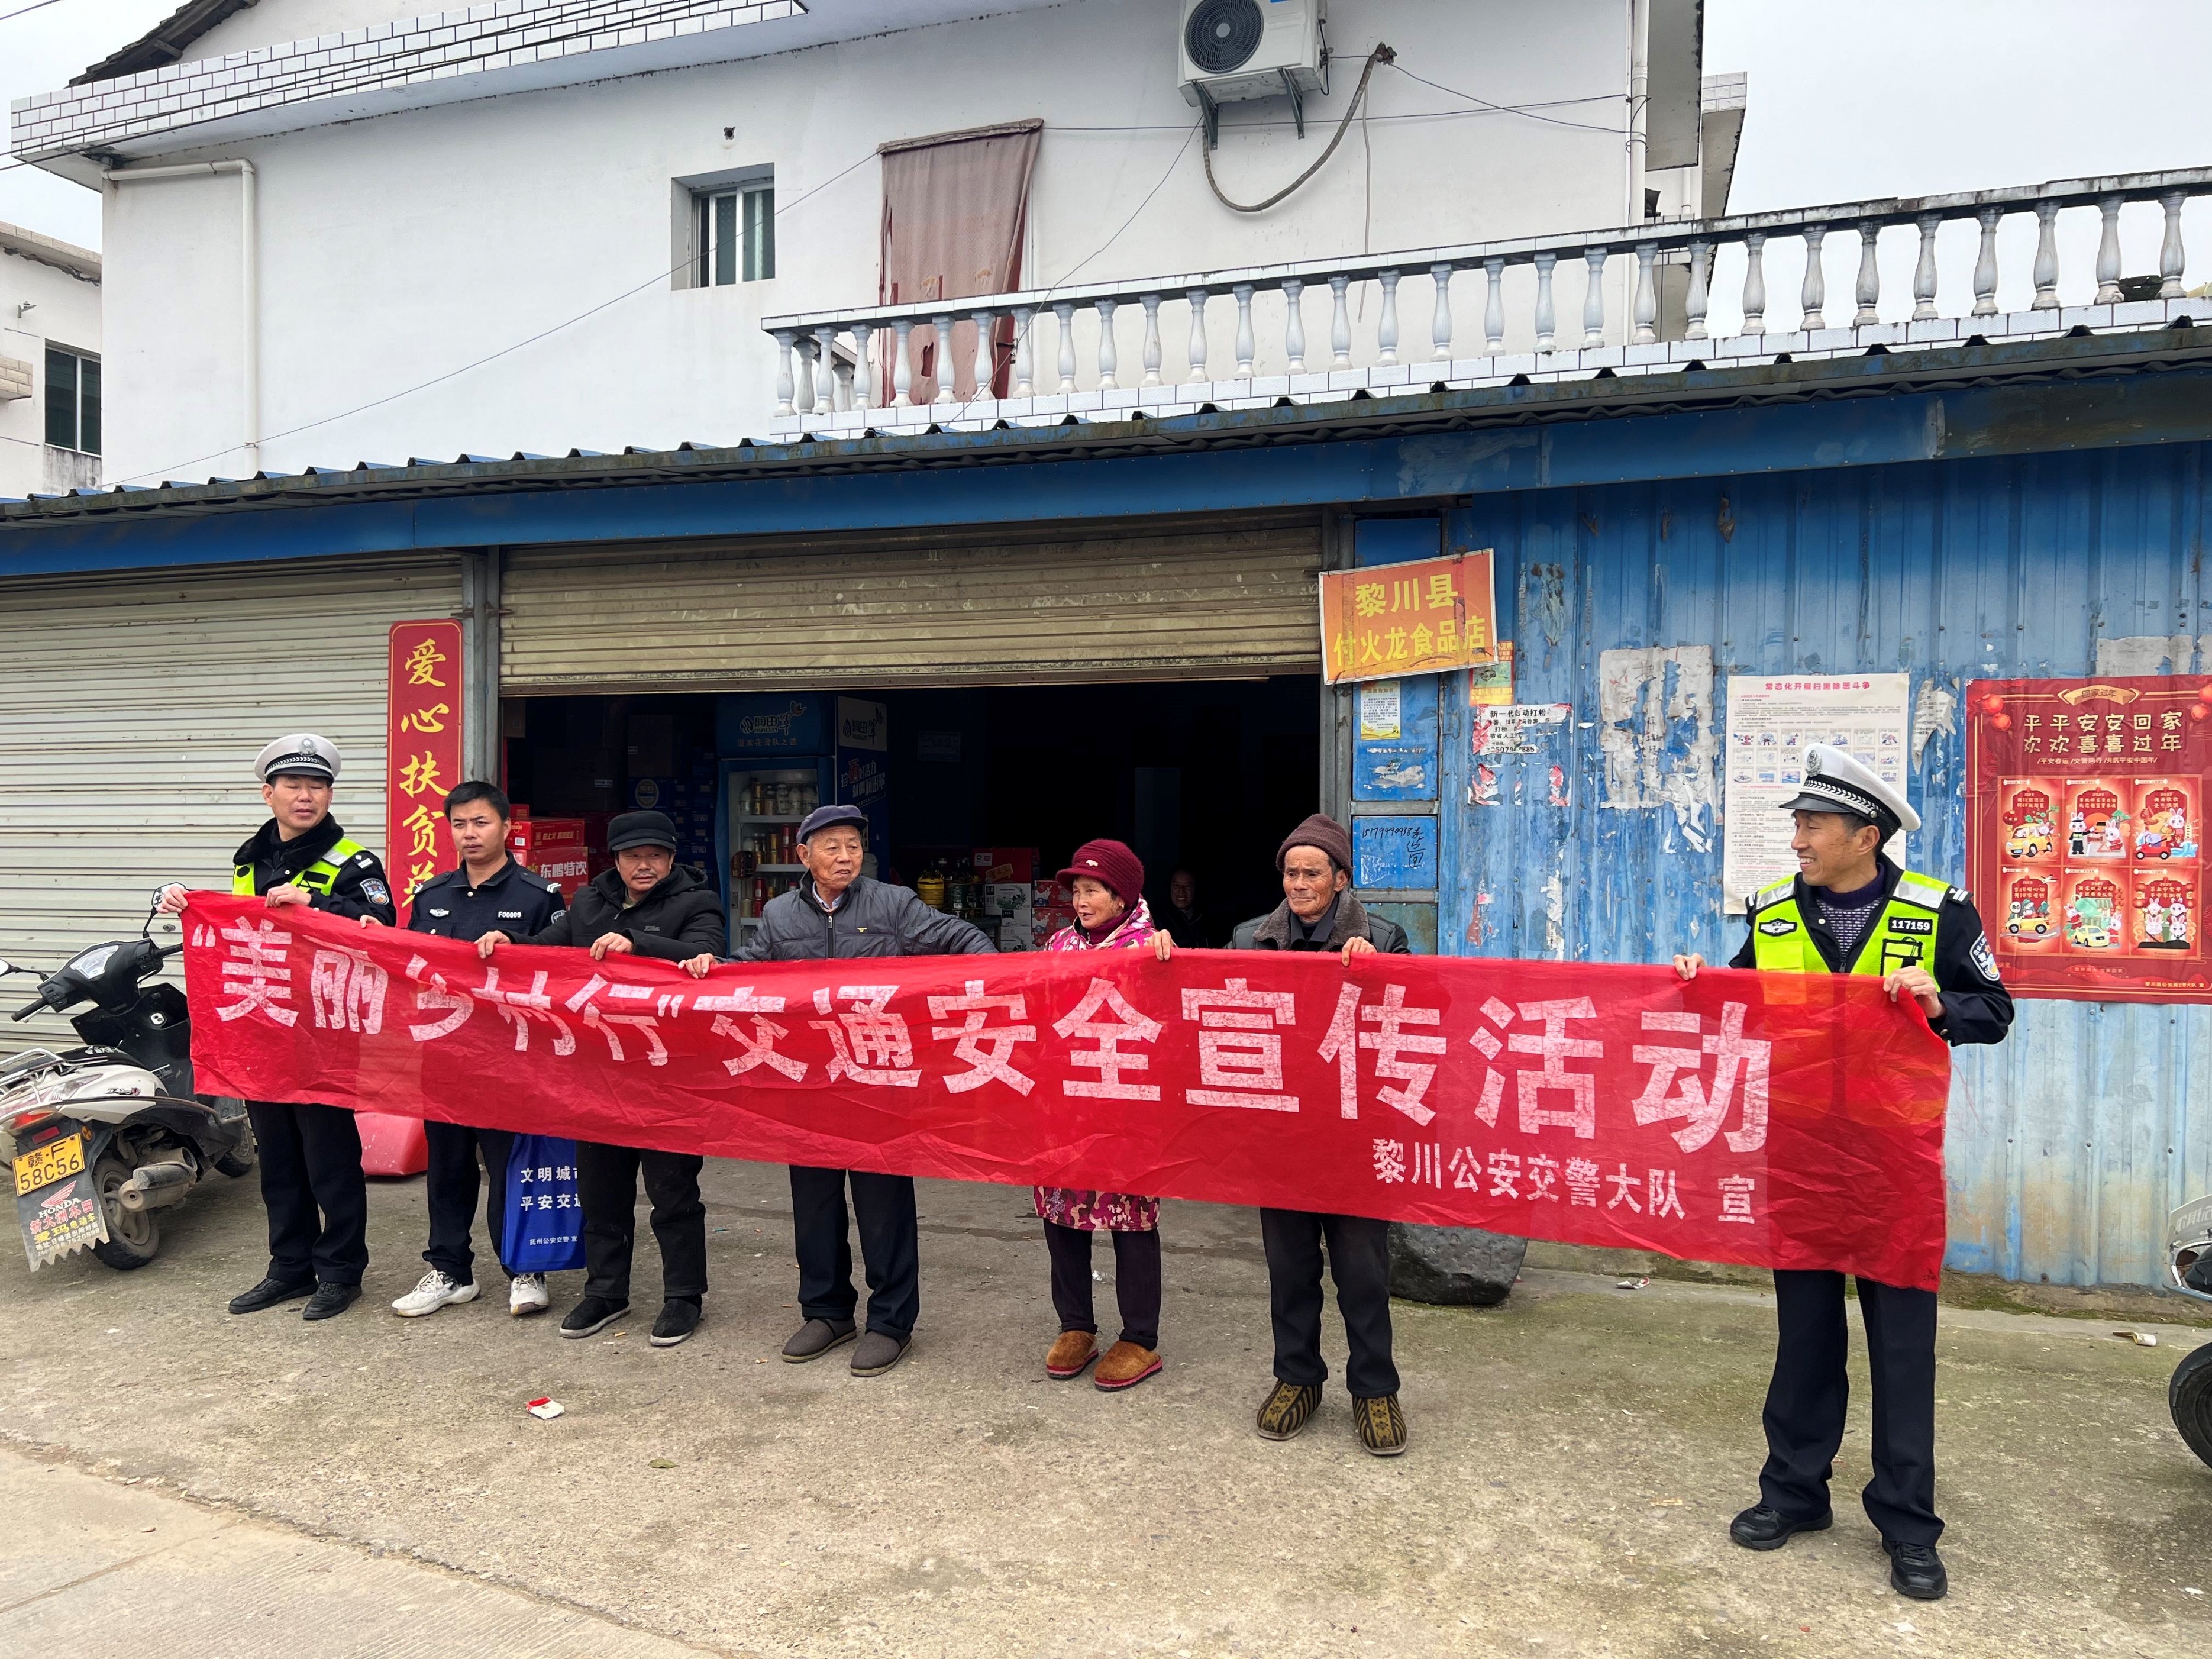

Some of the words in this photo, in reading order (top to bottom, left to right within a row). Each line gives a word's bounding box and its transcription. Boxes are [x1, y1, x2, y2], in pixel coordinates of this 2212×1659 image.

[1355, 573, 1458, 618] 黎川县
[1333, 615, 1486, 667] 付火龙食品店
[1765, 682, 1871, 690] 常态化开展扫黑除恶斗争
[2081, 689, 2116, 698] 回家过年
[2024, 711, 2182, 732] 平平安安回家
[2023, 733, 2182, 754] 欢欢喜喜过年
[540, 861, 587, 878] 东鹏特饮
[1891, 920, 1930, 931] 117159
[20, 1153, 79, 1190] 58C56
[1373, 1138, 1685, 1220] 黎川公安交警大队
[1717, 1173, 1755, 1224] 宣
[38, 1197, 82, 1218] HONDA
